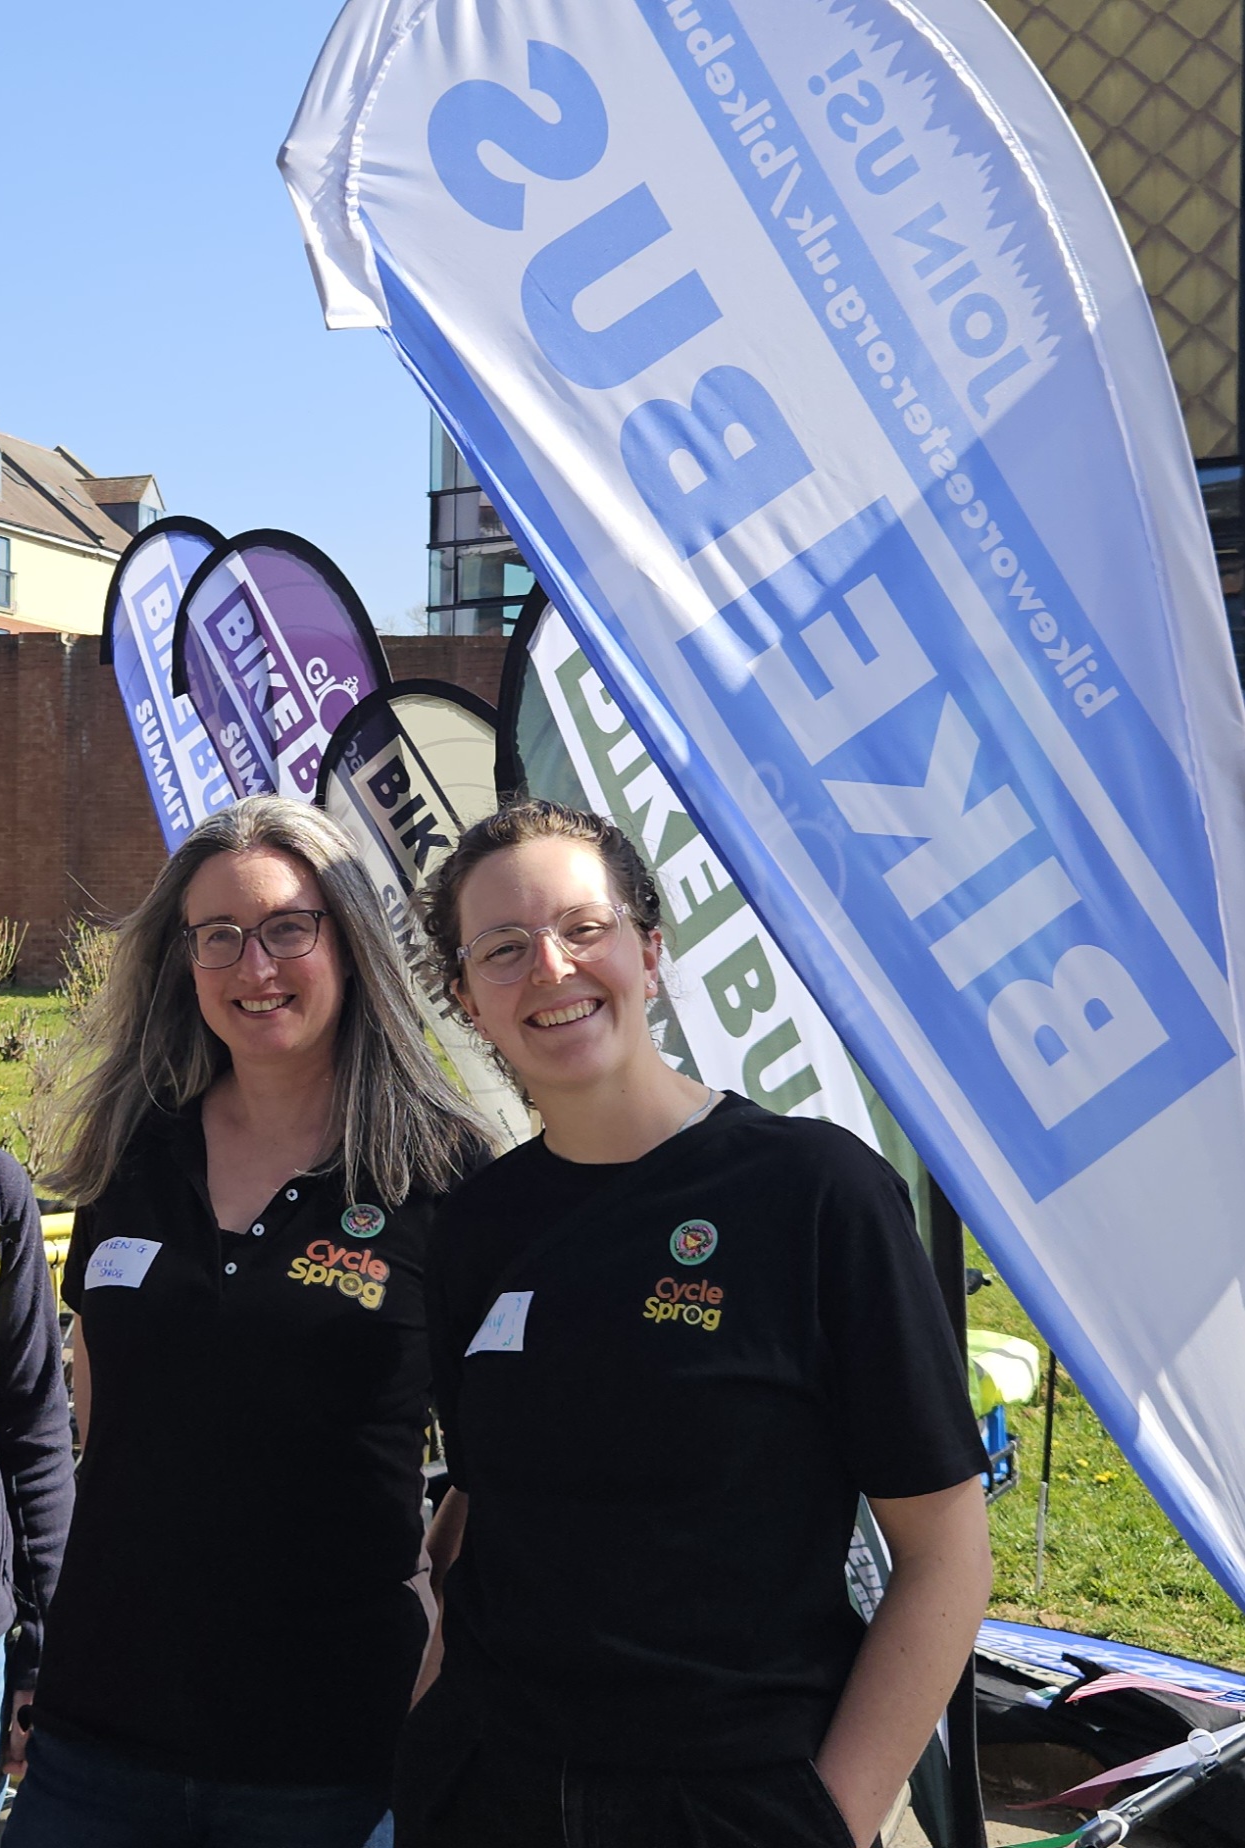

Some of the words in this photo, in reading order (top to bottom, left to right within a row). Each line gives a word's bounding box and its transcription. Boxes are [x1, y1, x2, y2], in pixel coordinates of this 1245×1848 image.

[216, 599, 304, 741] BIKE
[135, 698, 190, 831] SUMMIT
[188, 739, 237, 819] BU
[220, 721, 267, 796] SUM
[367, 755, 453, 874] BIK
[701, 933, 832, 1119] BU
[287, 1257, 387, 1311] Sprog
[306, 1239, 391, 1283] Cycle
[656, 1277, 724, 1304] Cycle
[643, 1296, 722, 1331] Sprog
